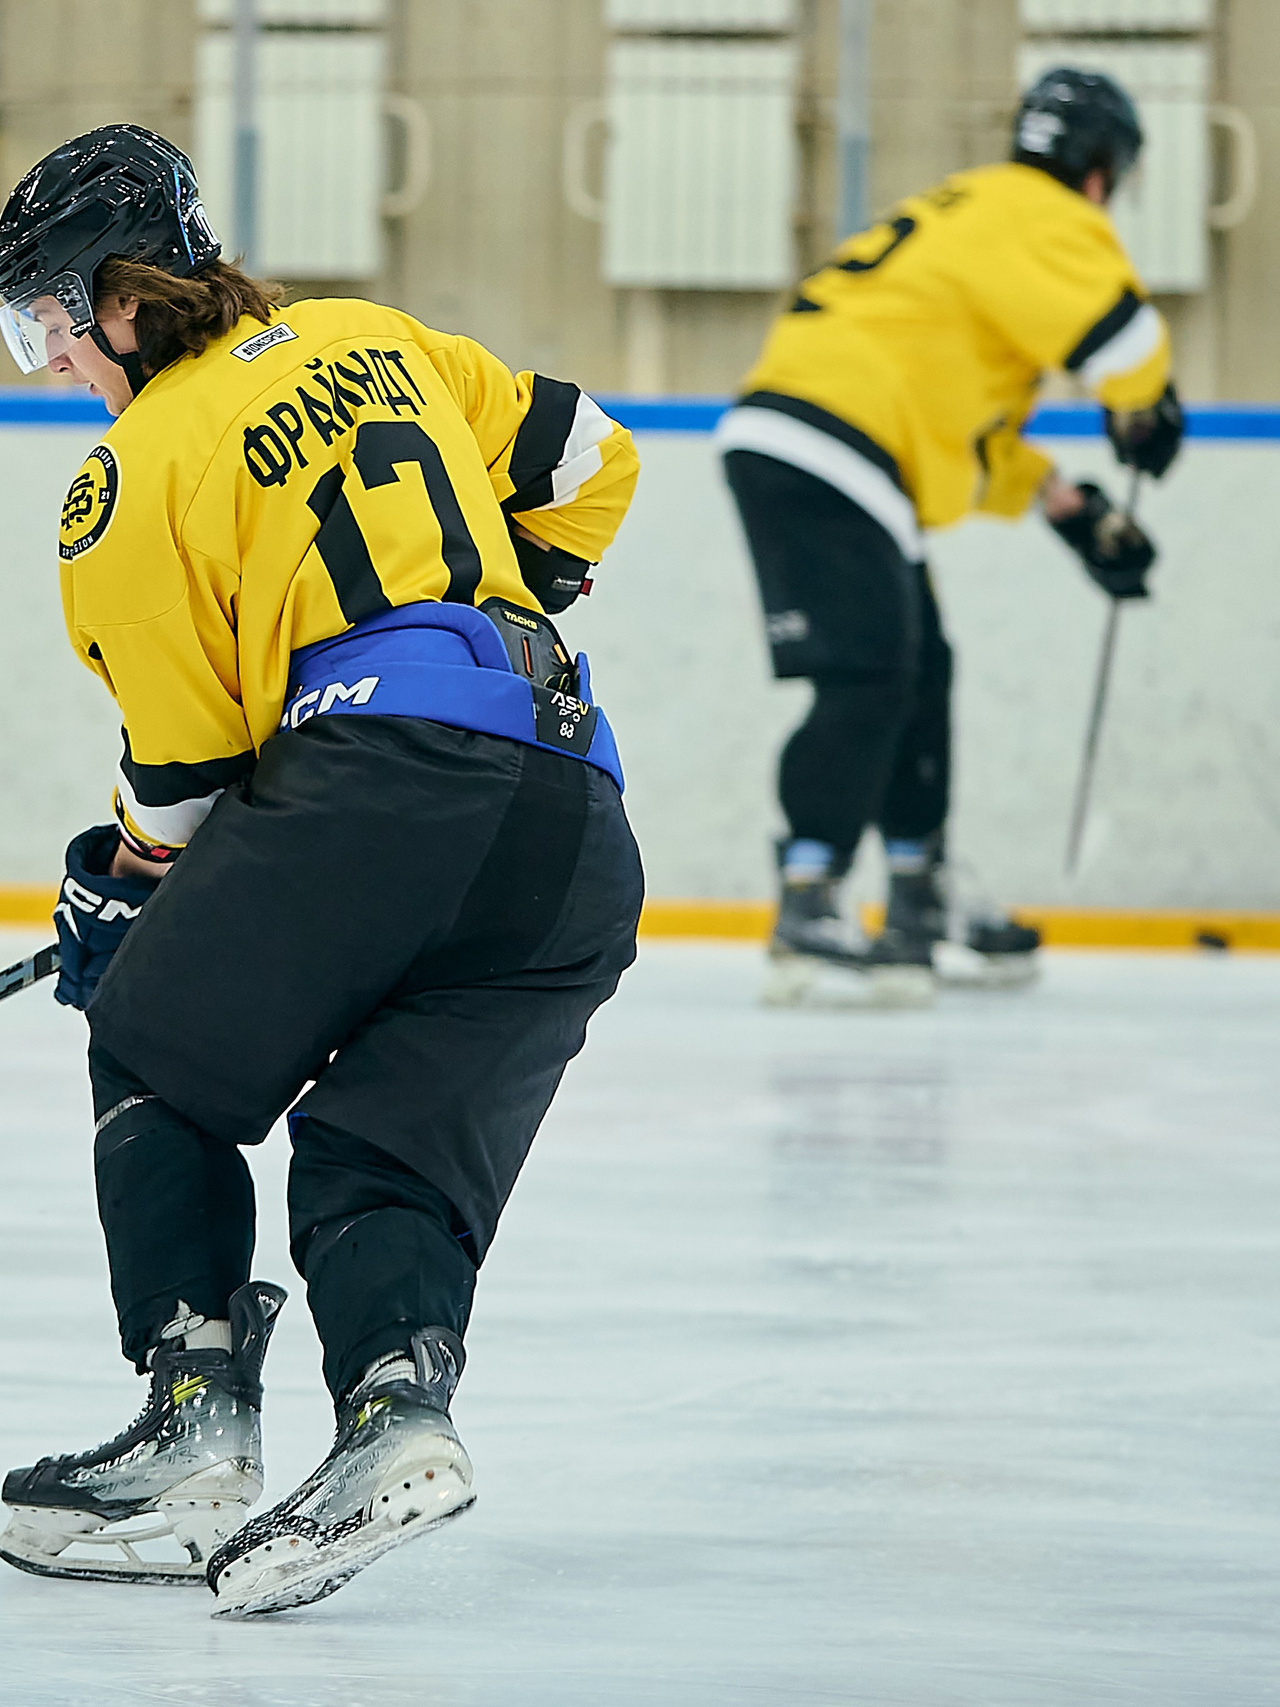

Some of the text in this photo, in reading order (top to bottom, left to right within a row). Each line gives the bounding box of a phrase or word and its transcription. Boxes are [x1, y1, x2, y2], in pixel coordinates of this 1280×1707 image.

[243, 348, 427, 488] ФРАЙНДТ
[306, 421, 483, 623] 17
[281, 676, 380, 729] CM
